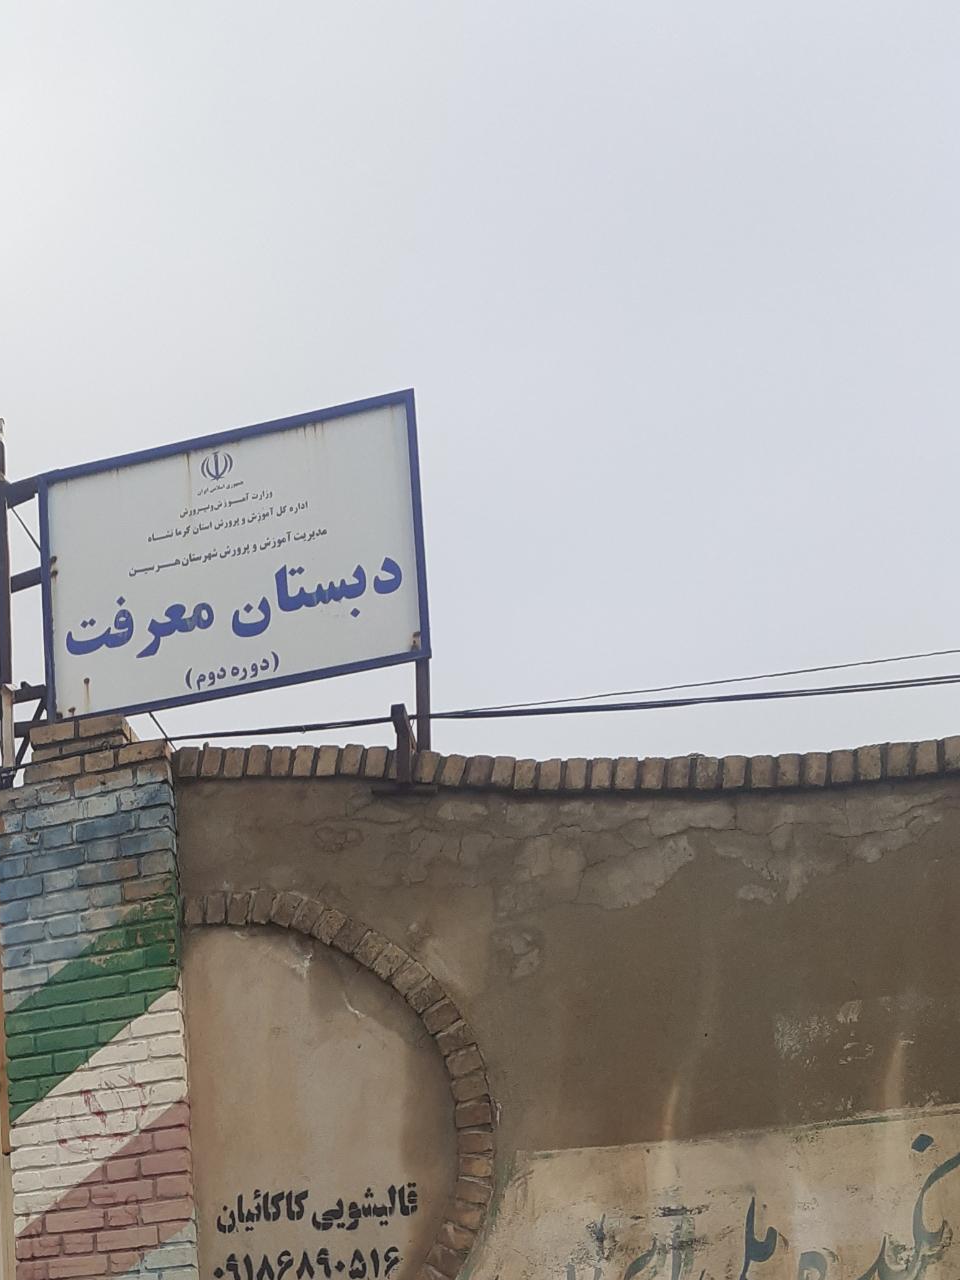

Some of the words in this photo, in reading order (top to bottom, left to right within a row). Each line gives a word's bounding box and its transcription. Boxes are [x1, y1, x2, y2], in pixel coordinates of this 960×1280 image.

[251, 490, 273, 500] وزارت
[247, 506, 274, 525] آموزش
[276, 505, 287, 518] کل
[289, 501, 309, 515] اداره
[192, 521, 213, 536] استان
[214, 517, 240, 531] پرورش
[241, 517, 246, 526] و
[259, 531, 292, 552] آموزش
[293, 528, 328, 543] مدیریت
[219, 541, 250, 560] پرورش
[252, 543, 257, 552] و
[181, 548, 218, 567] شهرستان
[128, 558, 181, 577] هرسین
[231, 555, 403, 638] دبستان
[65, 595, 215, 659] معرفت
[216, 1188, 310, 1234] کاکائیان
[311, 1182, 419, 1232] قالیشویی
